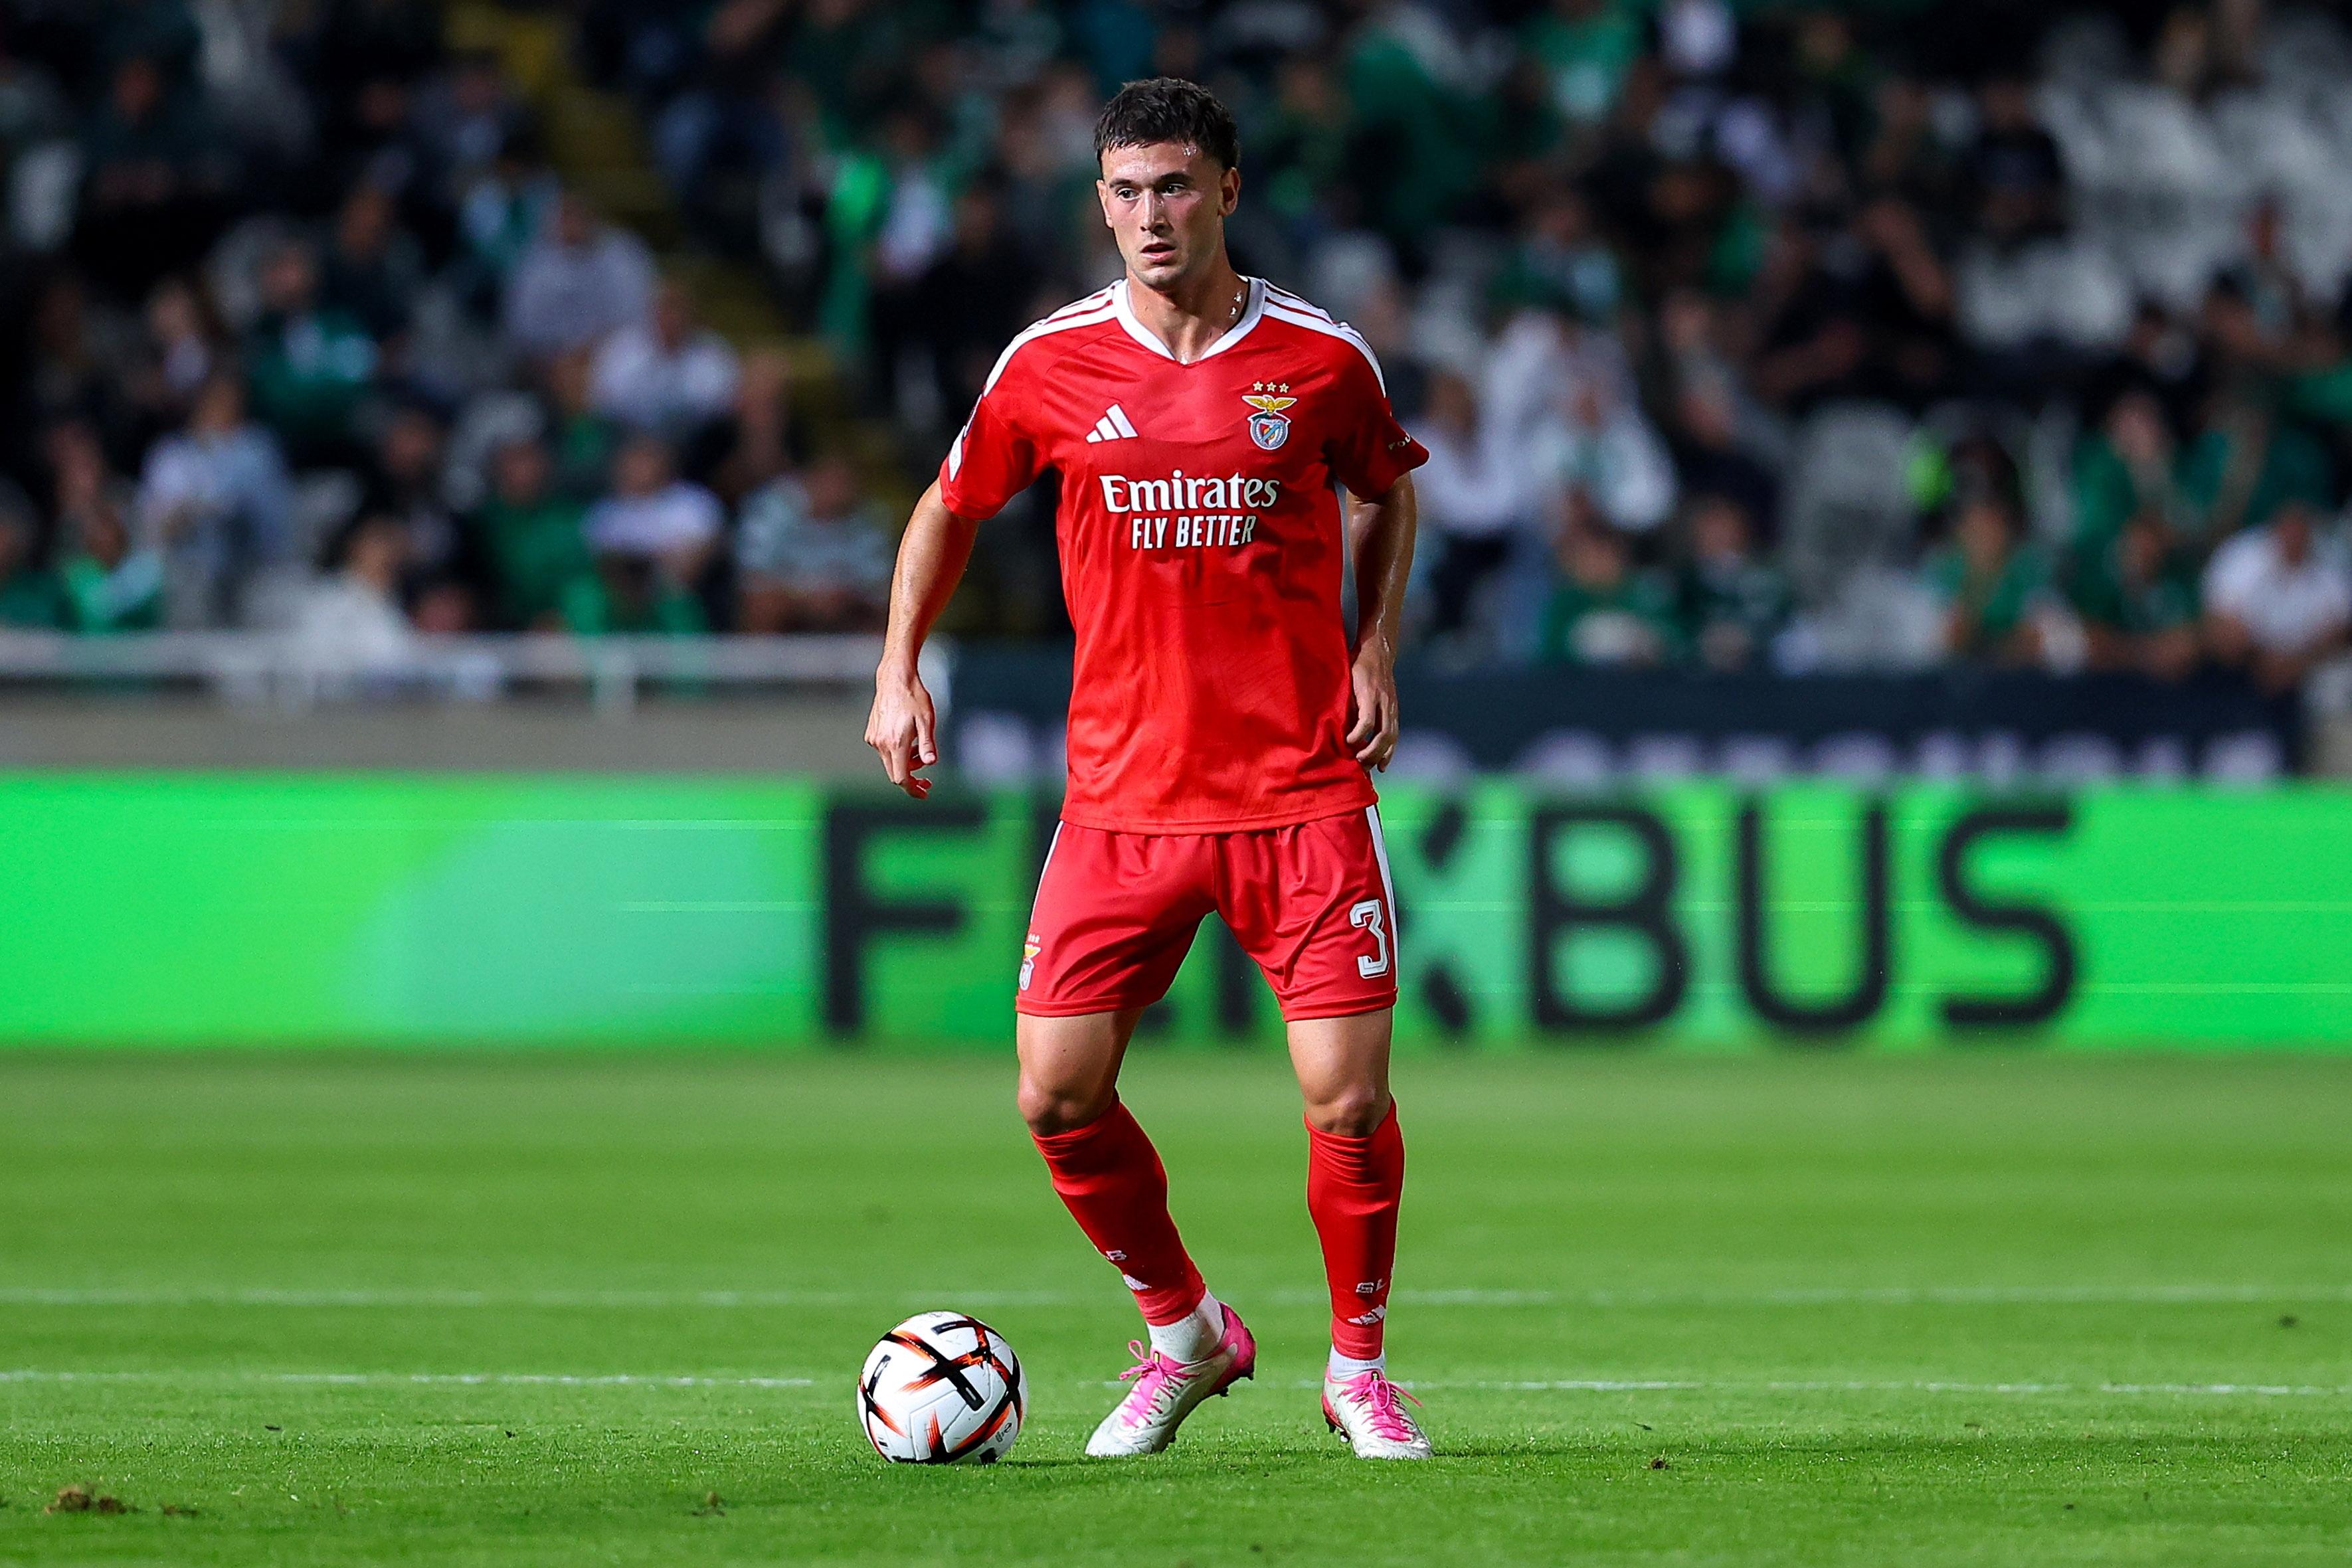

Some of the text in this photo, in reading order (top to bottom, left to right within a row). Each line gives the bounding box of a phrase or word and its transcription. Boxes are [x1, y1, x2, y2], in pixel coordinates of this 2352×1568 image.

[1099, 470, 1280, 513] Emirates
[1131, 515, 1257, 549] FLY BETTER
[826, 800, 2082, 1033] FBUS
[1350, 899, 1390, 979] 3
